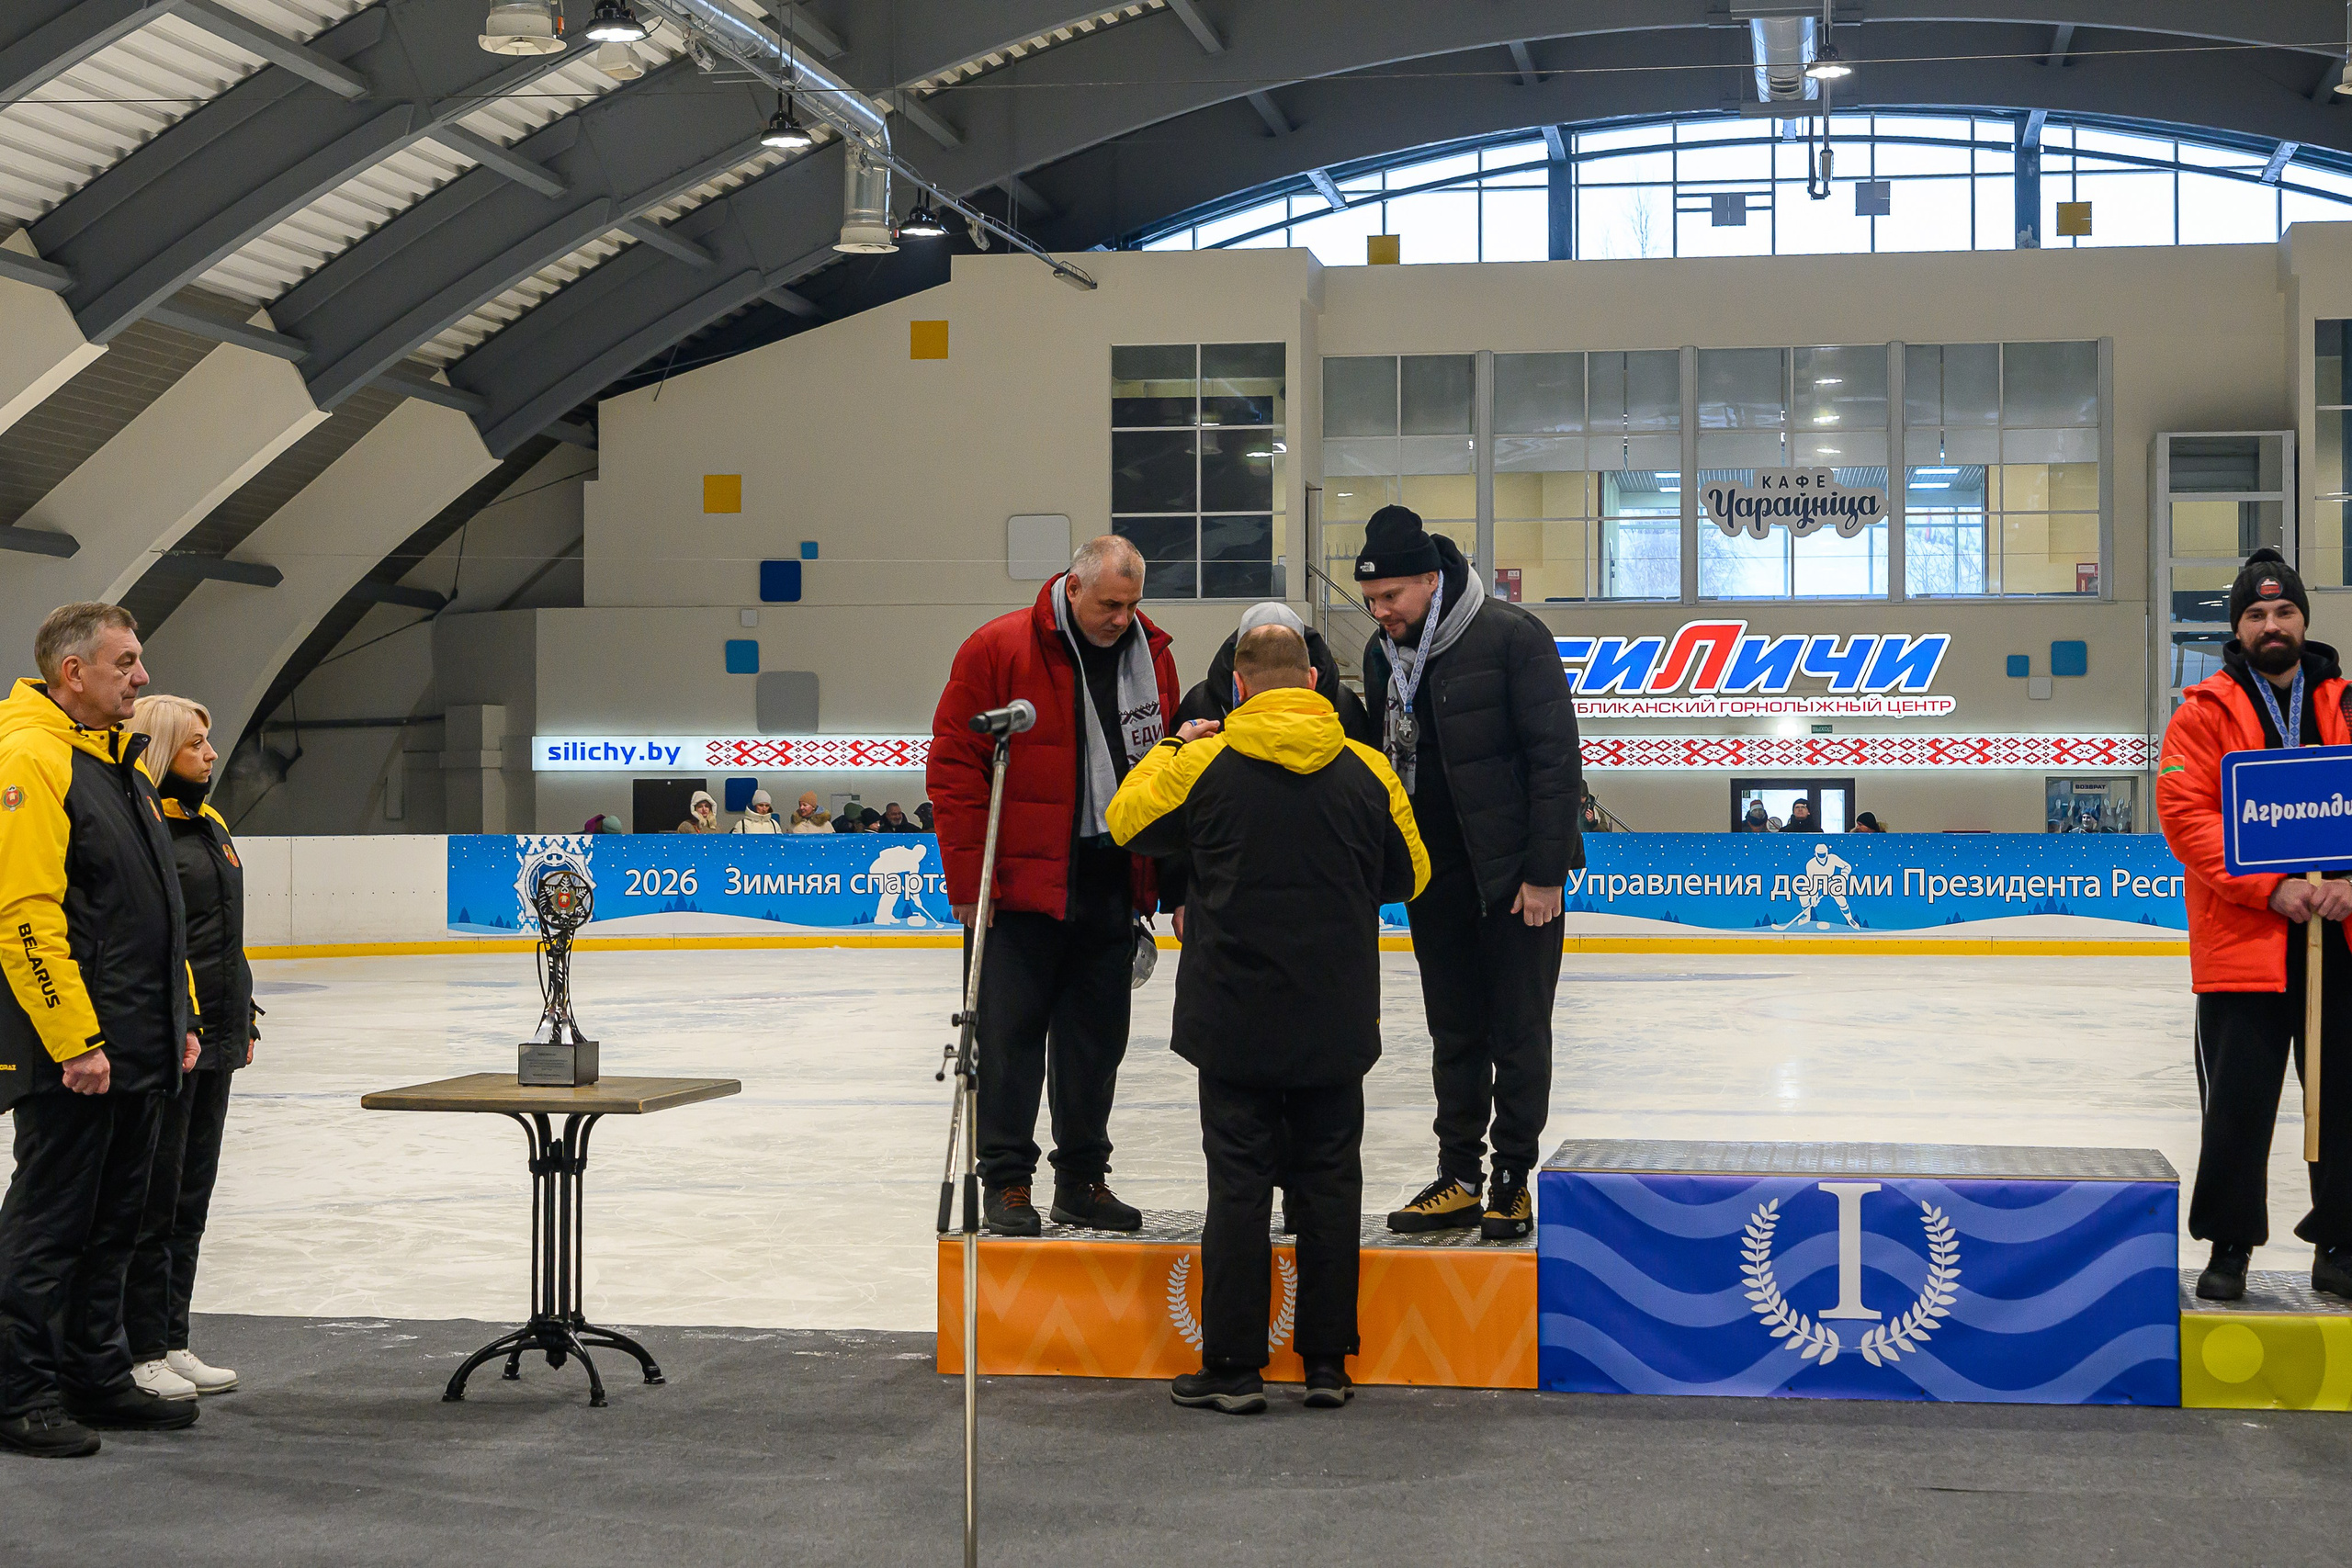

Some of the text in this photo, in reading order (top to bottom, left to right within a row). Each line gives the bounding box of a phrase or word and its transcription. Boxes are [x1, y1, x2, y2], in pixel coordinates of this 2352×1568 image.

[1762, 475, 1826, 489] КАФЕ
[1708, 488, 1881, 532] Чараўніца
[1572, 697, 1951, 714] БЛИКАНСКИЙ ГОРНОЛЫЖНЫЙ ЦЕНТР
[548, 741, 682, 765] silichy.by
[624, 868, 699, 897] 2026
[724, 866, 841, 896] Зимняя
[1566, 867, 1762, 902] Управления
[1770, 874, 1893, 901] делами
[1902, 868, 2101, 904] Президента
[18, 922, 61, 1009] BELARUS
